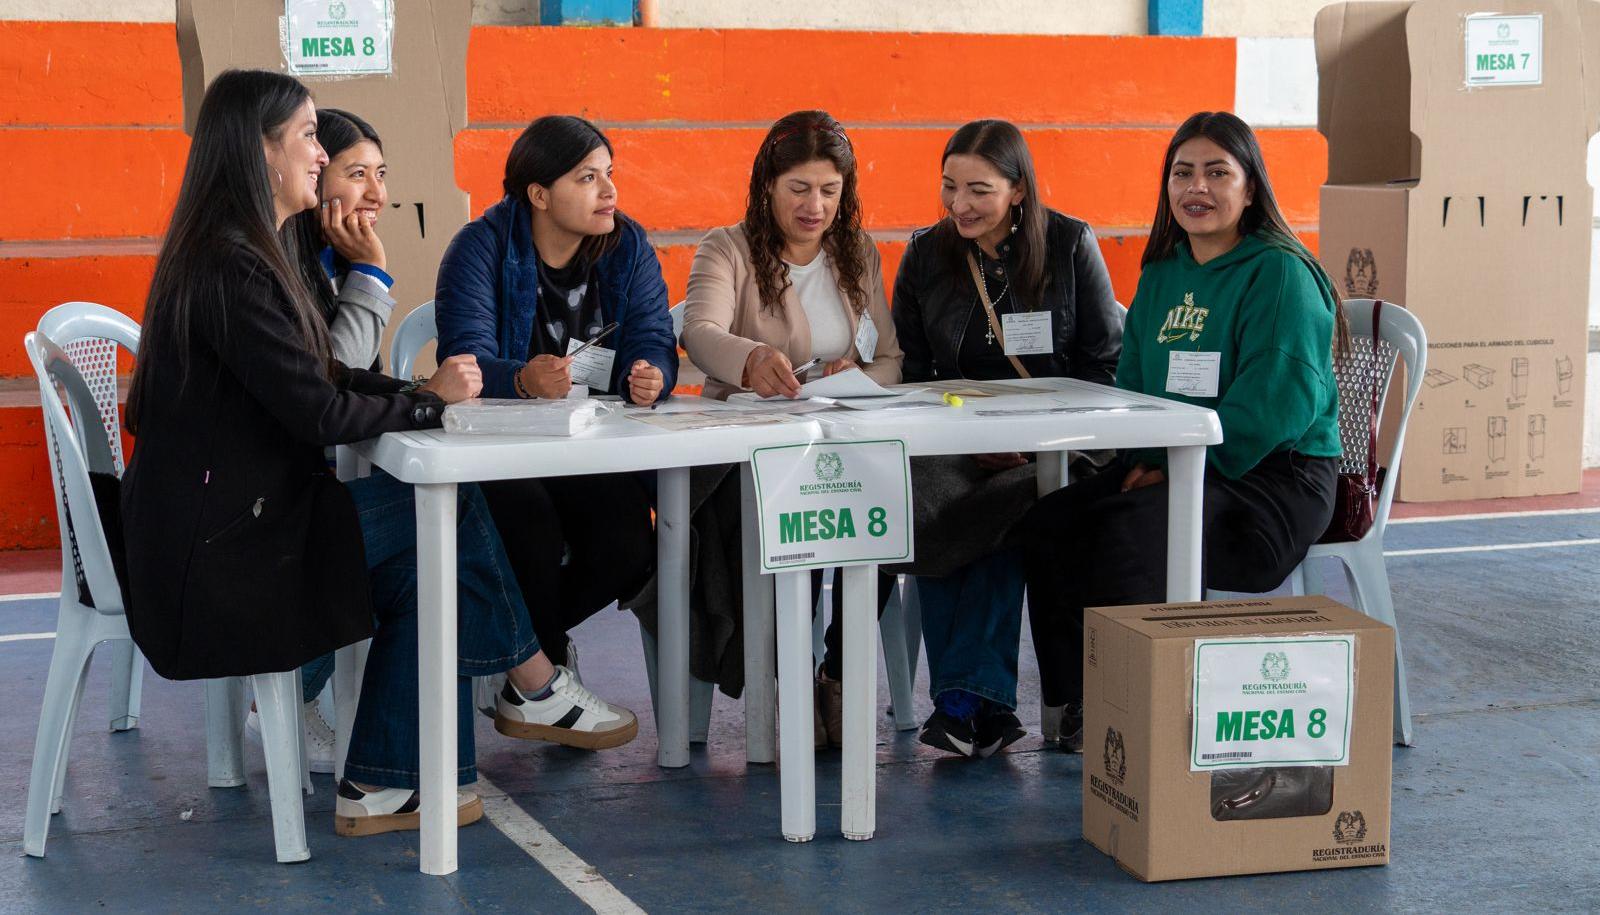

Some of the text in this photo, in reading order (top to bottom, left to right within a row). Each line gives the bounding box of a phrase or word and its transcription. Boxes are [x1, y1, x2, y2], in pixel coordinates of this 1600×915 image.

[302, 37, 375, 57] MESA 8
[1476, 53, 1531, 71] MESA 7
[1488, 339, 1513, 347] ARMADO
[779, 507, 888, 544] MESA 8
[1215, 708, 1327, 742] MESA 8
[1312, 843, 1386, 857] REGISTRADURÍA
